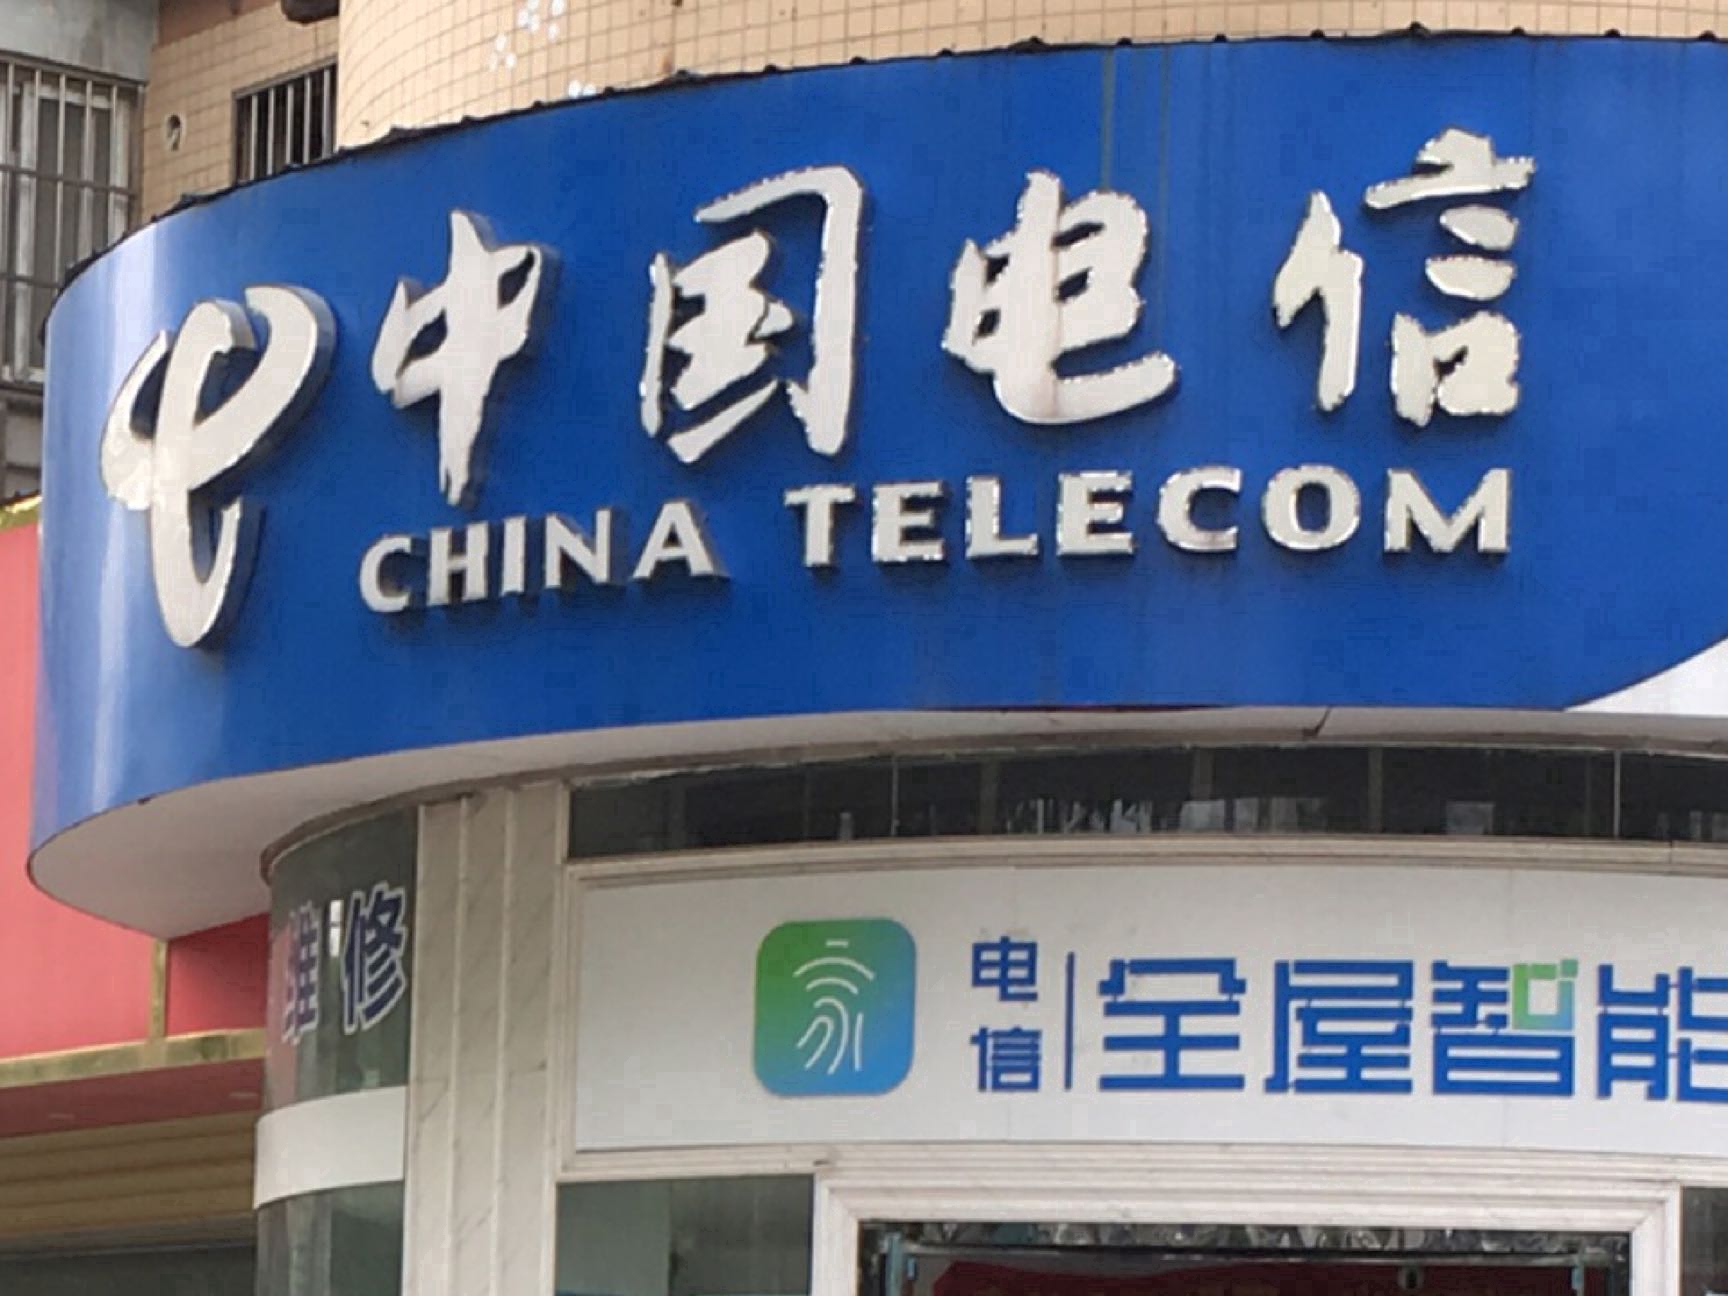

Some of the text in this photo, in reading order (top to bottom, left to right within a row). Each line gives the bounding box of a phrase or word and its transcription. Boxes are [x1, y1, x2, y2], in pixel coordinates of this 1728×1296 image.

[371, 126, 1538, 507] 中国电信
[359, 464, 1513, 614] CHINA TELECOM
[971, 936, 1042, 1092] 电信
[1098, 957, 1728, 1104] 全屋智能
